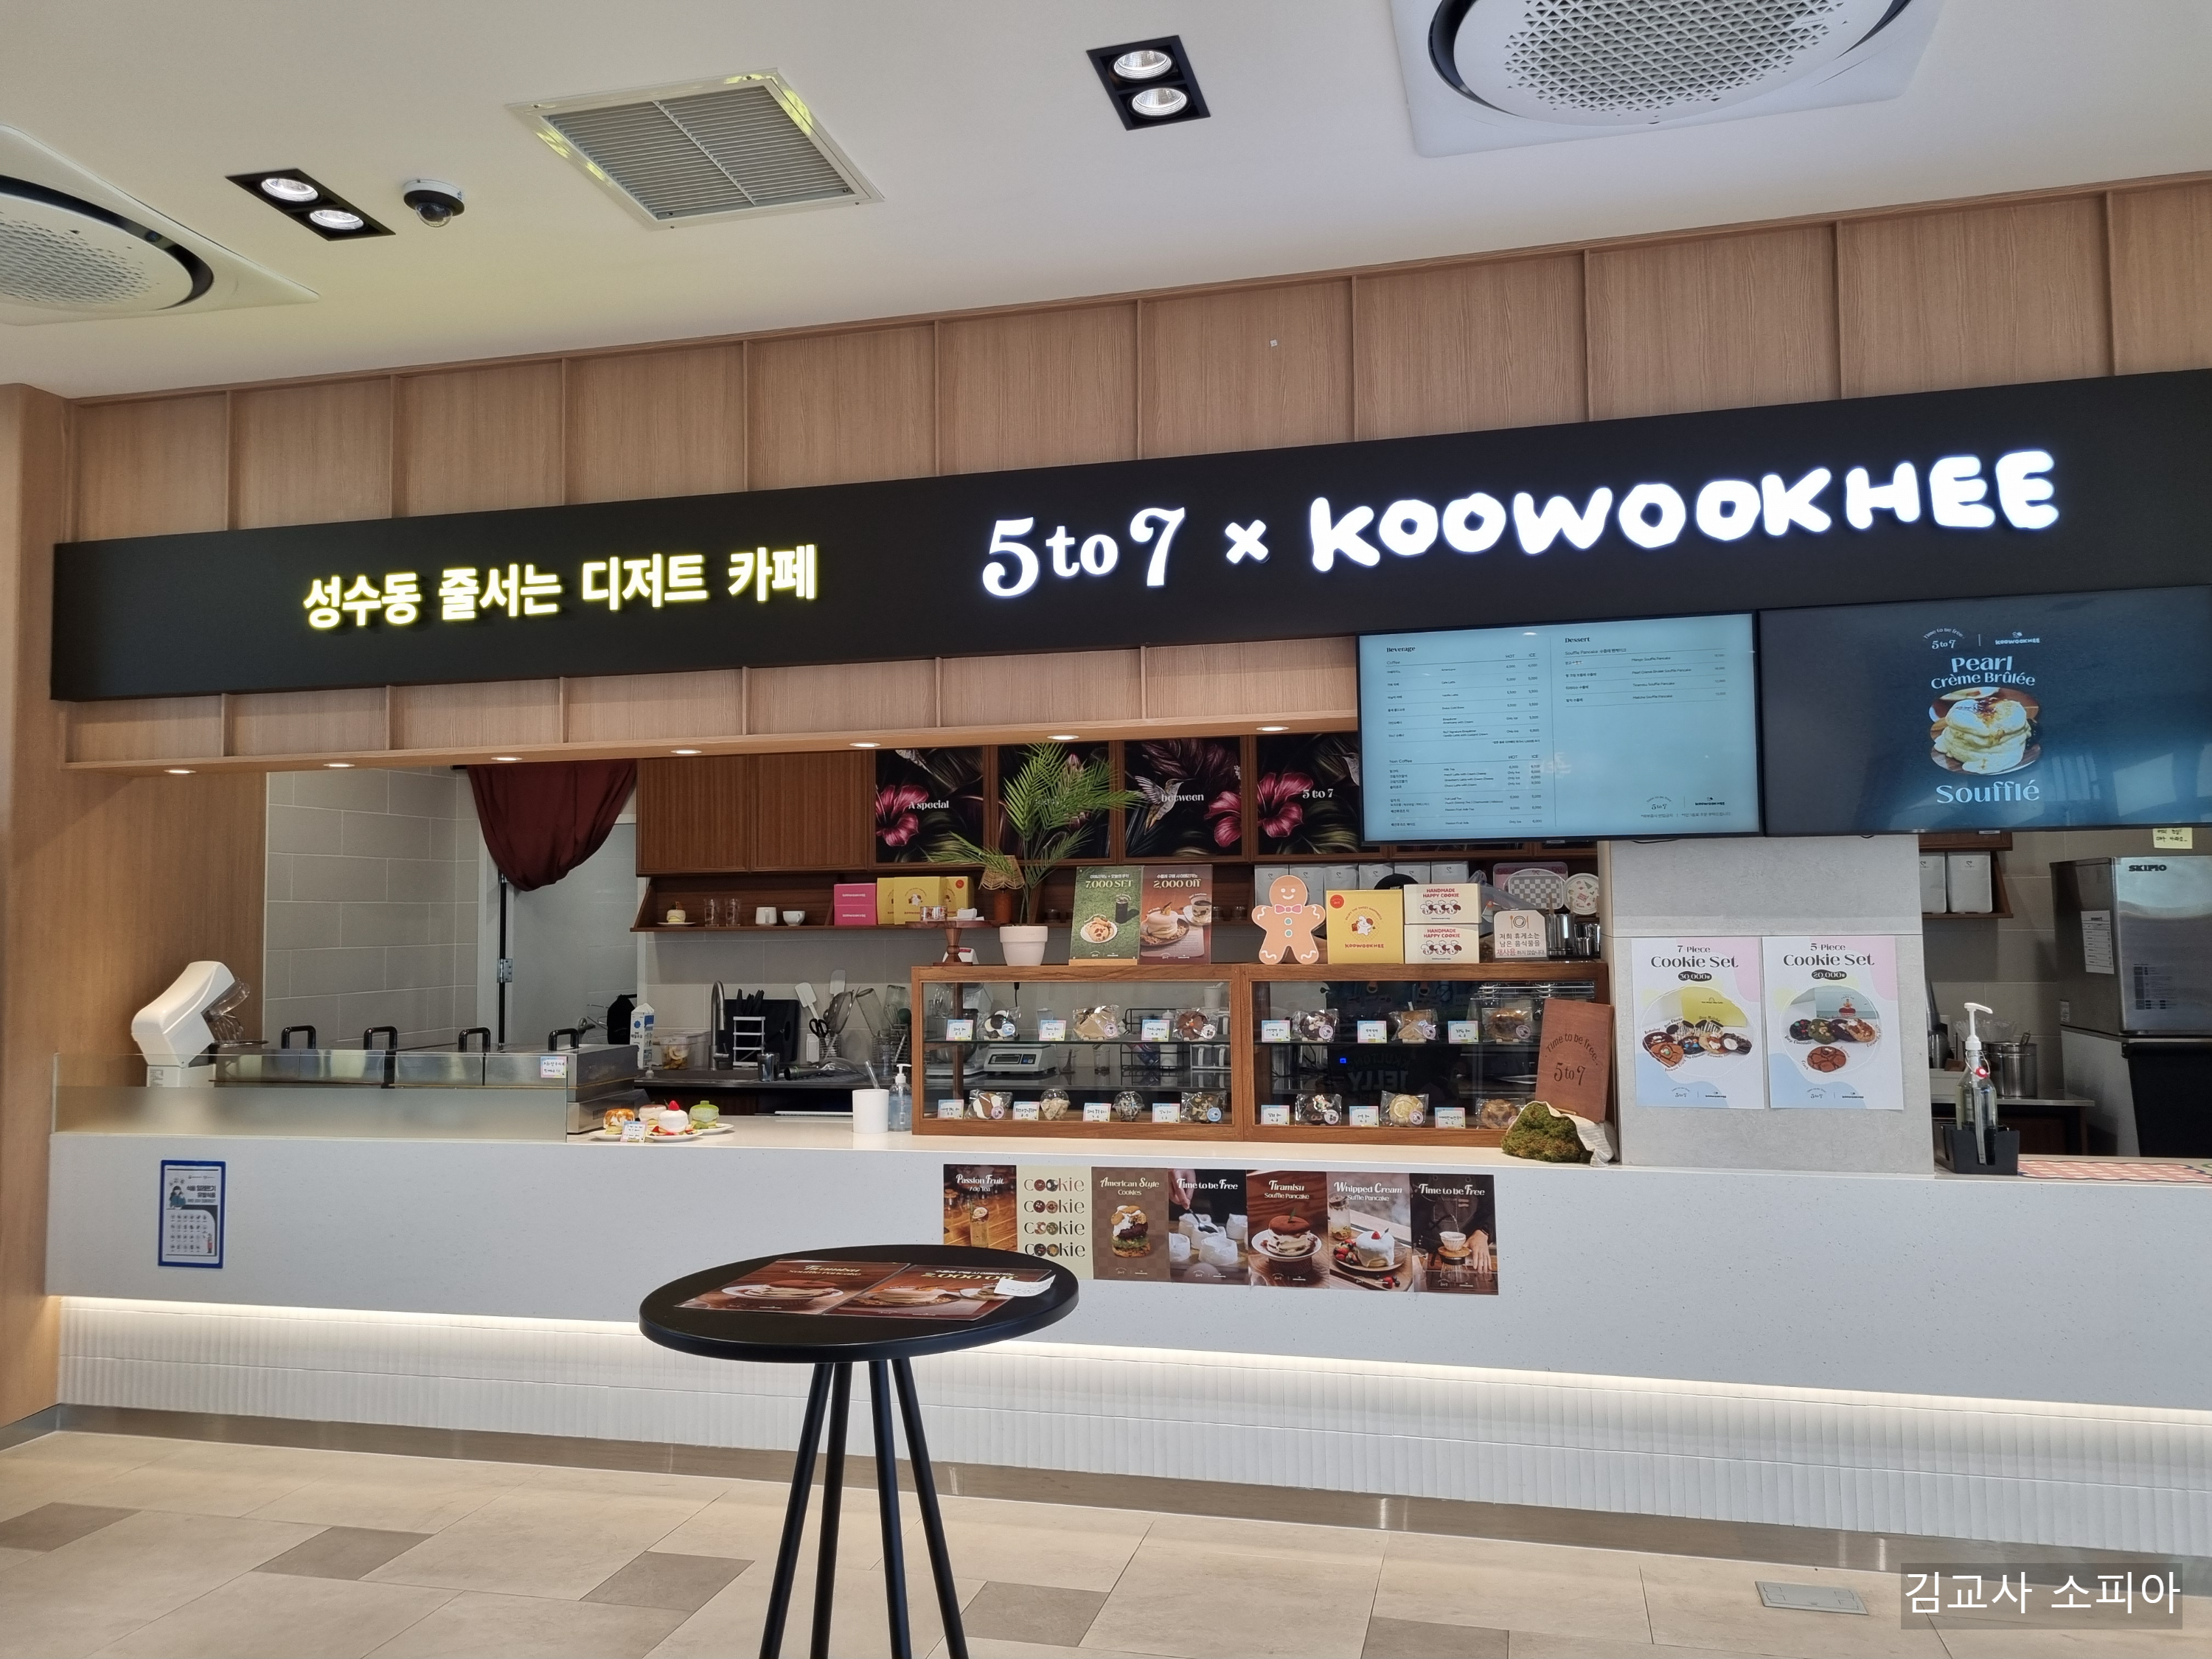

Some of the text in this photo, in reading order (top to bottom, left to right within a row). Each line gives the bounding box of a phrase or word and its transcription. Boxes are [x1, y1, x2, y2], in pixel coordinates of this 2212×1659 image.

[1310, 450, 2059, 573] KOOWOOKHEE
[303, 543, 817, 628] 성수동 줄서는 디저트 카페
[1951, 656, 2012, 672] Pearl
[1931, 671, 2035, 689] Crème Brûlée
[1161, 793, 1204, 801] between
[1302, 788, 1334, 799] 5 to 7
[1936, 779, 2039, 804] Soufflé
[908, 799, 950, 811] A special
[1085, 880, 1133, 888] 7,000 SET
[1153, 880, 1183, 888] 2,000
[1651, 956, 1739, 968] Cookie Set
[1783, 953, 1875, 967] Cookie Set
[1546, 1036, 1563, 1053] Time
[1565, 1033, 1572, 1042] to
[1574, 1034, 1583, 1044] be
[956, 1174, 1004, 1185] Passion Fruit
[1100, 1177, 1160, 1189] American Style
[1177, 1178, 1197, 1189] Time
[1208, 1180, 1219, 1189] be
[1219, 1179, 1238, 1189] Free
[1269, 1180, 1304, 1191] Tiramisu
[1334, 1182, 1402, 1193] Whipped Cream
[1419, 1183, 1485, 1195] Time to be Free
